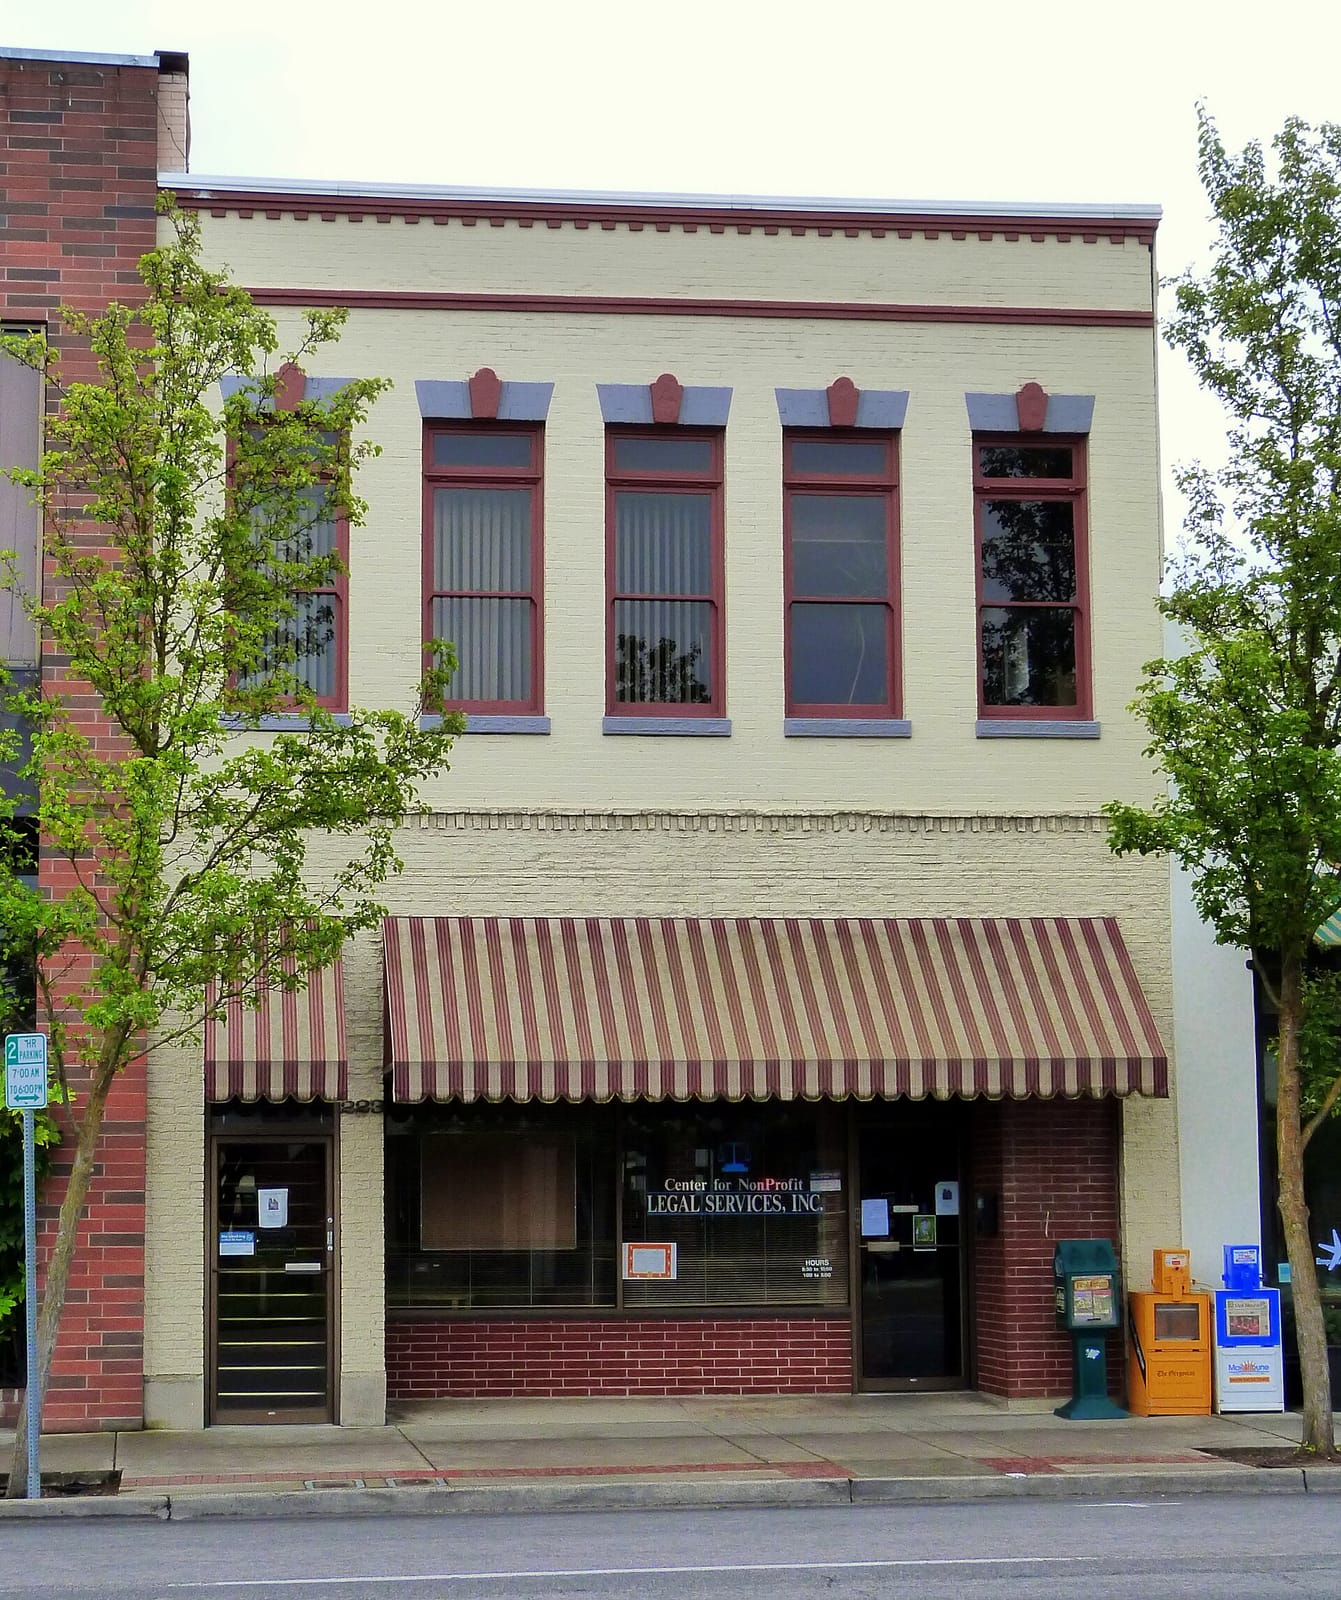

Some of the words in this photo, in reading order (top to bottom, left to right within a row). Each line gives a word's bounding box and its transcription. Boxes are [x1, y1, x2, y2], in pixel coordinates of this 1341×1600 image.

[8, 1041, 17, 1059] 2
[27, 1039, 37, 1049] HR
[19, 1050, 43, 1061] PARKING
[12, 1068, 30, 1079] 7:00
[30, 1067, 40, 1078] AM
[10, 1086, 18, 1095] TO
[18, 1085, 34, 1095] 6:00
[34, 1084, 43, 1094] PM
[664, 1178, 708, 1192] Center
[713, 1178, 732, 1192] for
[738, 1178, 804, 1192] NonProfit
[647, 1194, 700, 1213] LEGAL
[705, 1194, 786, 1214] SERVICES,
[791, 1193, 824, 1213] INC.
